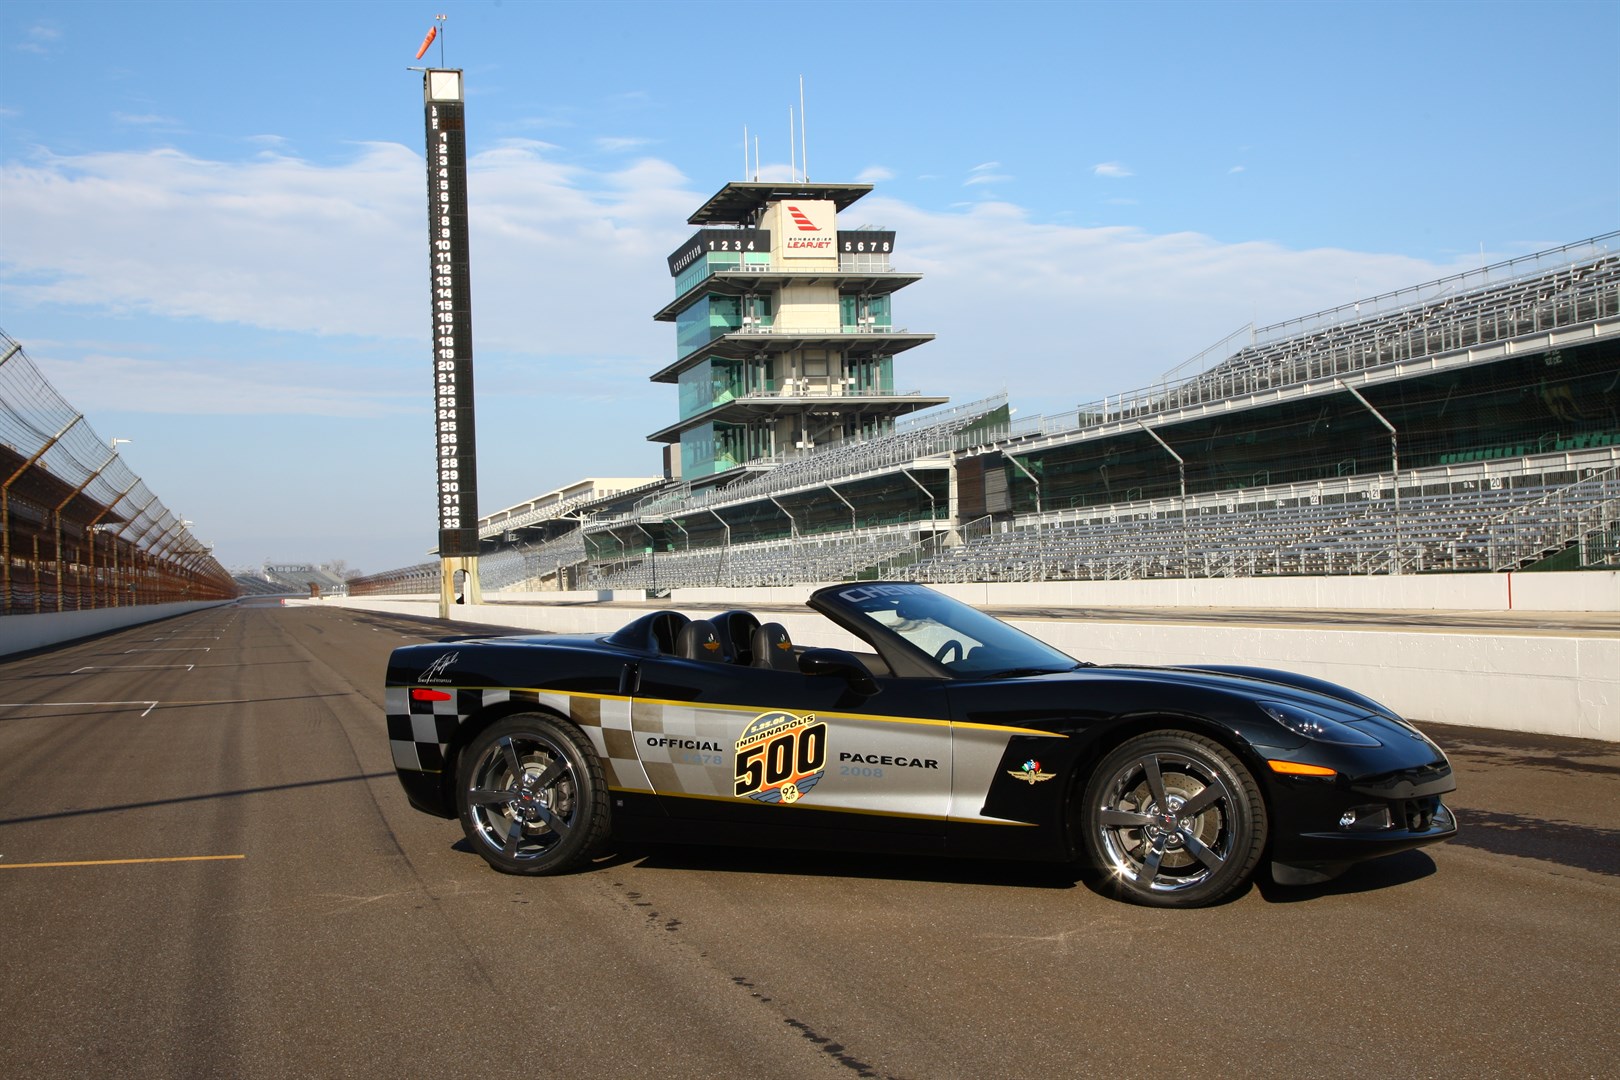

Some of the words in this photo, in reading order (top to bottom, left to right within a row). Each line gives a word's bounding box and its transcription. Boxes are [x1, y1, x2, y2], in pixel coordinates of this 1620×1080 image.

[440, 132, 448, 142] 1
[438, 144, 448, 154] 2
[440, 156, 448, 166] 3
[438, 168, 448, 178] 4
[440, 180, 448, 190] 5
[440, 192, 448, 202] 6
[440, 204, 450, 214] 7
[440, 216, 450, 226] 8
[442, 228, 450, 238] 9
[436, 240, 450, 250] 10
[708, 240, 714, 250] 1
[722, 240, 728, 250] 2
[734, 240, 741, 250] 3
[747, 240, 754, 250] 4
[845, 242, 851, 251] 5
[858, 242, 864, 251] 6
[870, 242, 877, 251] 7
[883, 242, 889, 251] 8
[436, 252, 452, 262] 11
[436, 264, 452, 274] 12
[436, 276, 452, 286] 13
[436, 288, 452, 298] 14
[436, 300, 452, 310] 15
[438, 312, 454, 322] 16
[438, 324, 454, 334] 17
[438, 336, 454, 346] 18
[438, 348, 454, 358] 19
[438, 360, 454, 372] 20
[438, 372, 456, 384] 21
[438, 384, 456, 396] 22
[438, 396, 456, 408] 23
[438, 408, 456, 420] 24
[440, 420, 456, 432] 25
[440, 432, 458, 444] 26
[440, 444, 458, 456] 27
[442, 458, 458, 468] 28
[442, 470, 458, 480] 29
[442, 482, 458, 492] 30
[1492, 478, 1500, 487] 20
[1372, 489, 1378, 498] 21
[442, 494, 460, 504] 31
[1312, 495, 1318, 503] 22
[442, 506, 460, 516] 32
[444, 518, 460, 528] 33
[736, 714, 814, 748] INDIANAPOLIS
[646, 737, 722, 752] OFFICIAL
[735, 723, 826, 796] 500
[840, 752, 938, 769] PACECAR
[840, 765, 883, 778] 2008
[782, 785, 795, 796] 92
